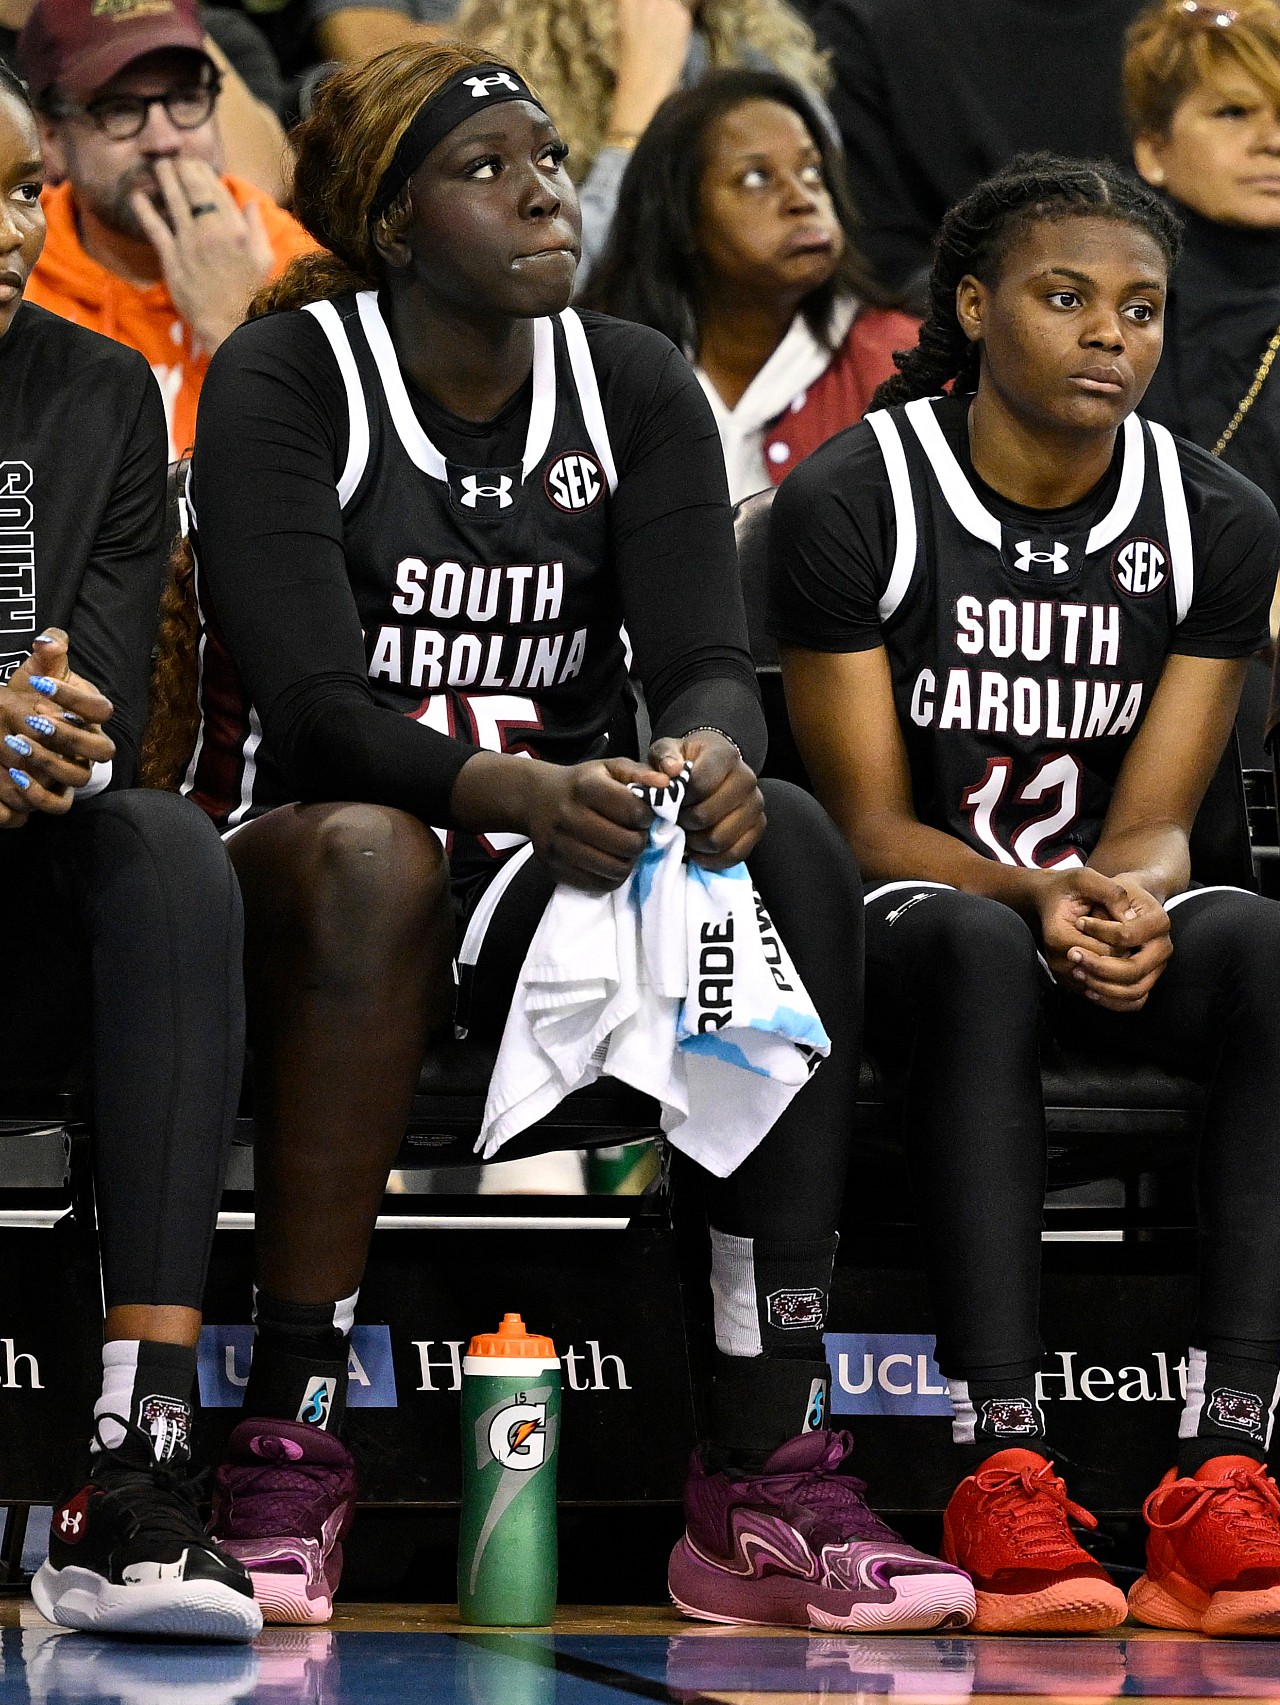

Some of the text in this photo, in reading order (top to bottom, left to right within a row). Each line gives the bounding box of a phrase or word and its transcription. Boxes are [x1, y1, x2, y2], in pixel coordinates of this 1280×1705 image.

[549, 455, 601, 509] SEC
[391, 557, 564, 623] SOUTH
[1116, 541, 1166, 593] SEC
[361, 625, 588, 688] AROLINA
[955, 594, 1120, 666] SOUTH
[910, 667, 1144, 739] CAROLINA
[960, 751, 1089, 871] 12
[838, 1351, 1192, 1402] UCL Healt
